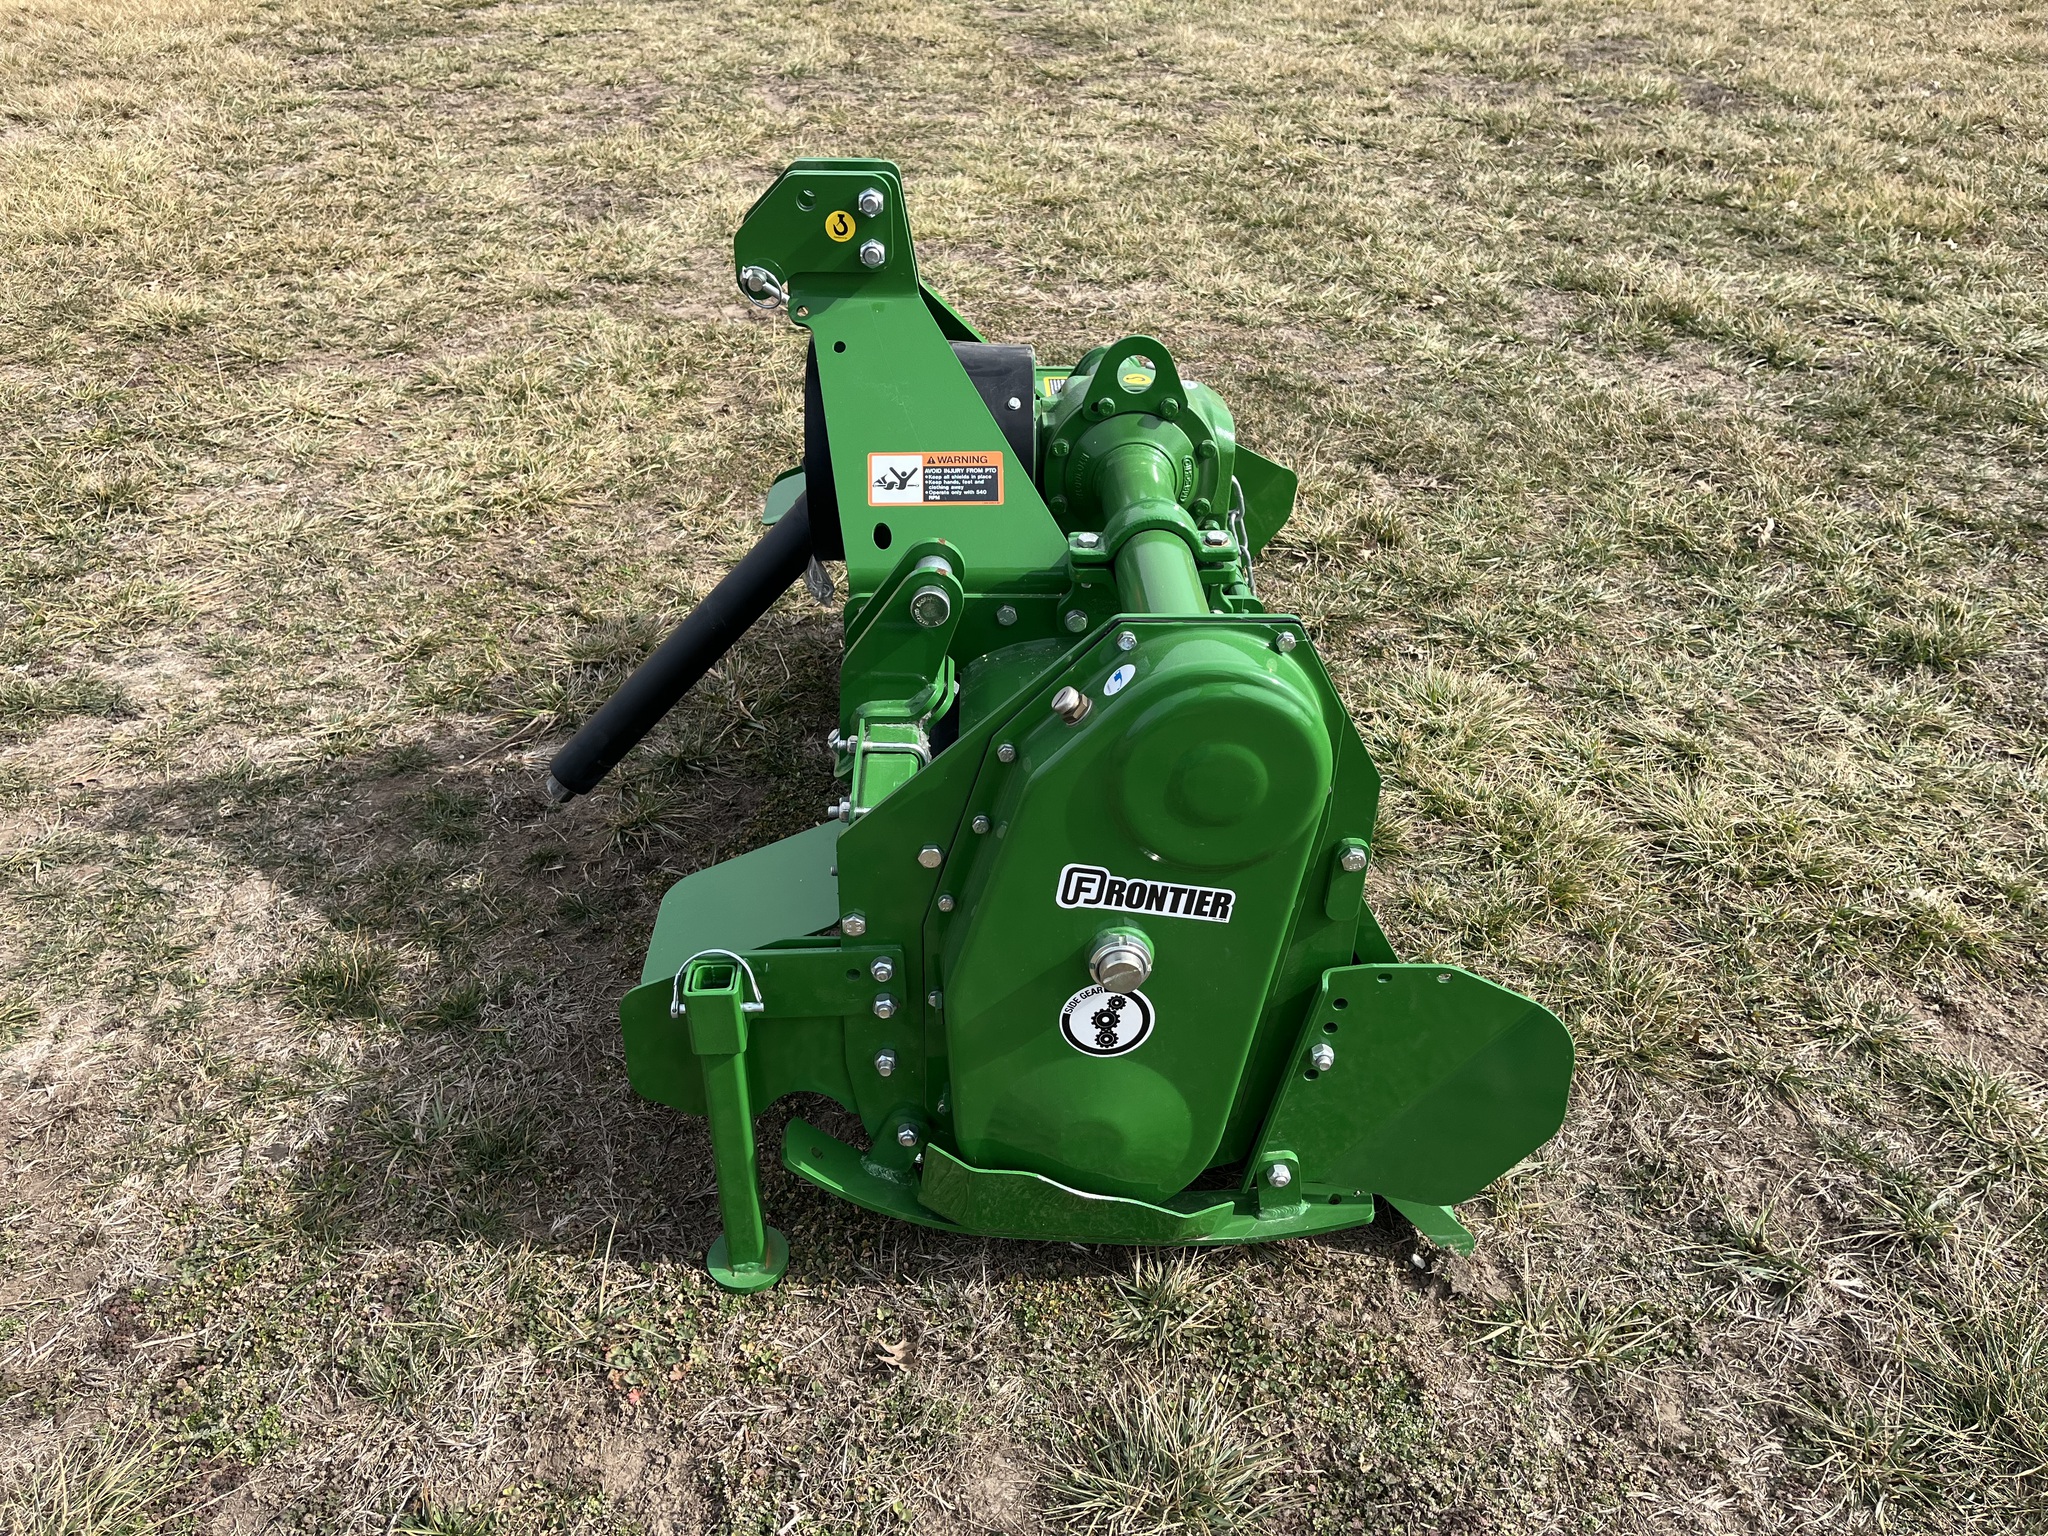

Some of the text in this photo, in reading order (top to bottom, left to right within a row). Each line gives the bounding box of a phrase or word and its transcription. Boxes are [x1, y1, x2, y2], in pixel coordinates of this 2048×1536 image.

[937, 455, 988, 464] WARNING
[1061, 866, 1233, 919] FRONTIER
[1064, 986, 1104, 1013] SIDE GEAR
